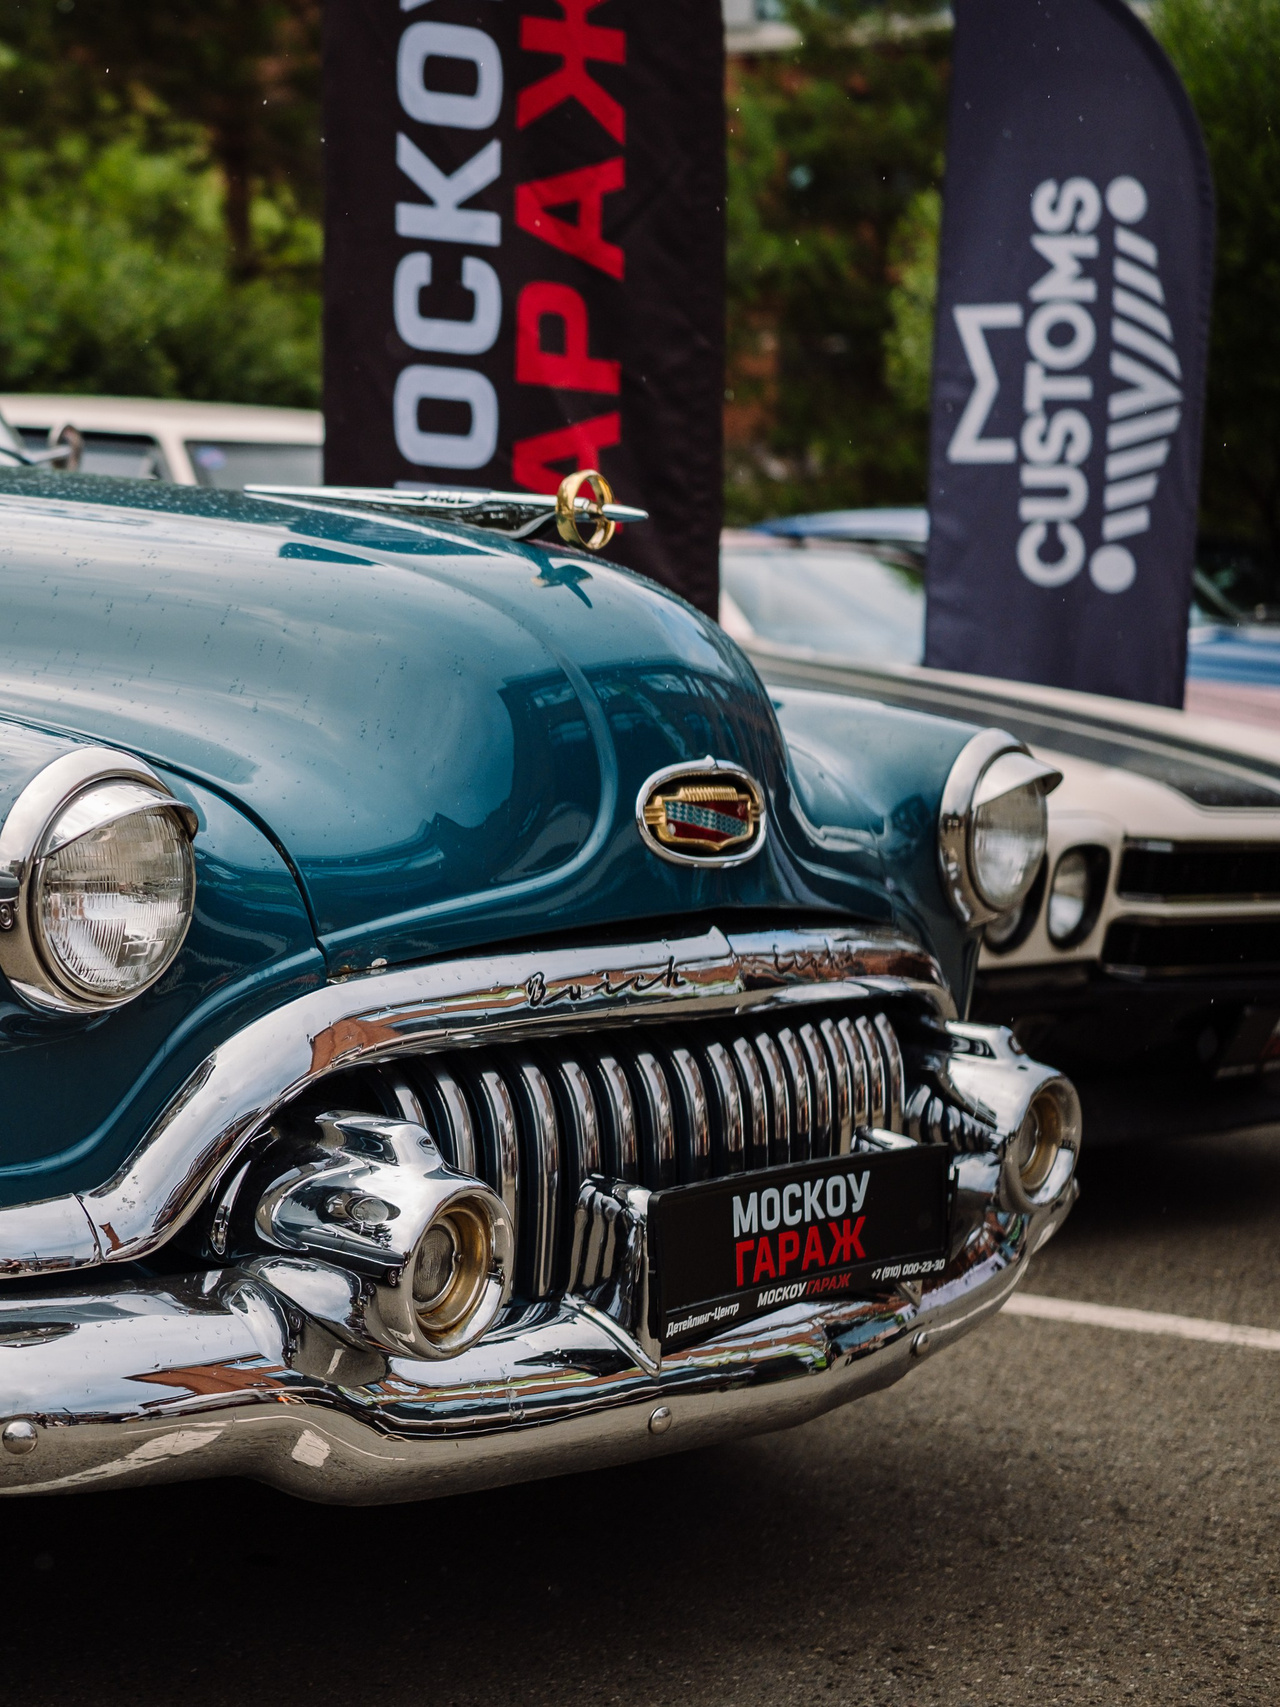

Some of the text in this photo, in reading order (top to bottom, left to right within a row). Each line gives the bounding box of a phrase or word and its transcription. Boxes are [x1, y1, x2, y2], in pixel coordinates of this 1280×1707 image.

[393, 0, 503, 493] ОСКО
[1016, 176, 1103, 588] CUSTOMS
[732, 1169, 870, 1238] МОСКОУ
[735, 1215, 867, 1287] ГАРАЖ
[665, 1302, 740, 1339] Детейлинг-Центр
[871, 1267, 882, 1280] +7
[881, 1264, 902, 1282] (910)
[901, 1258, 946, 1276] 000-23-30
